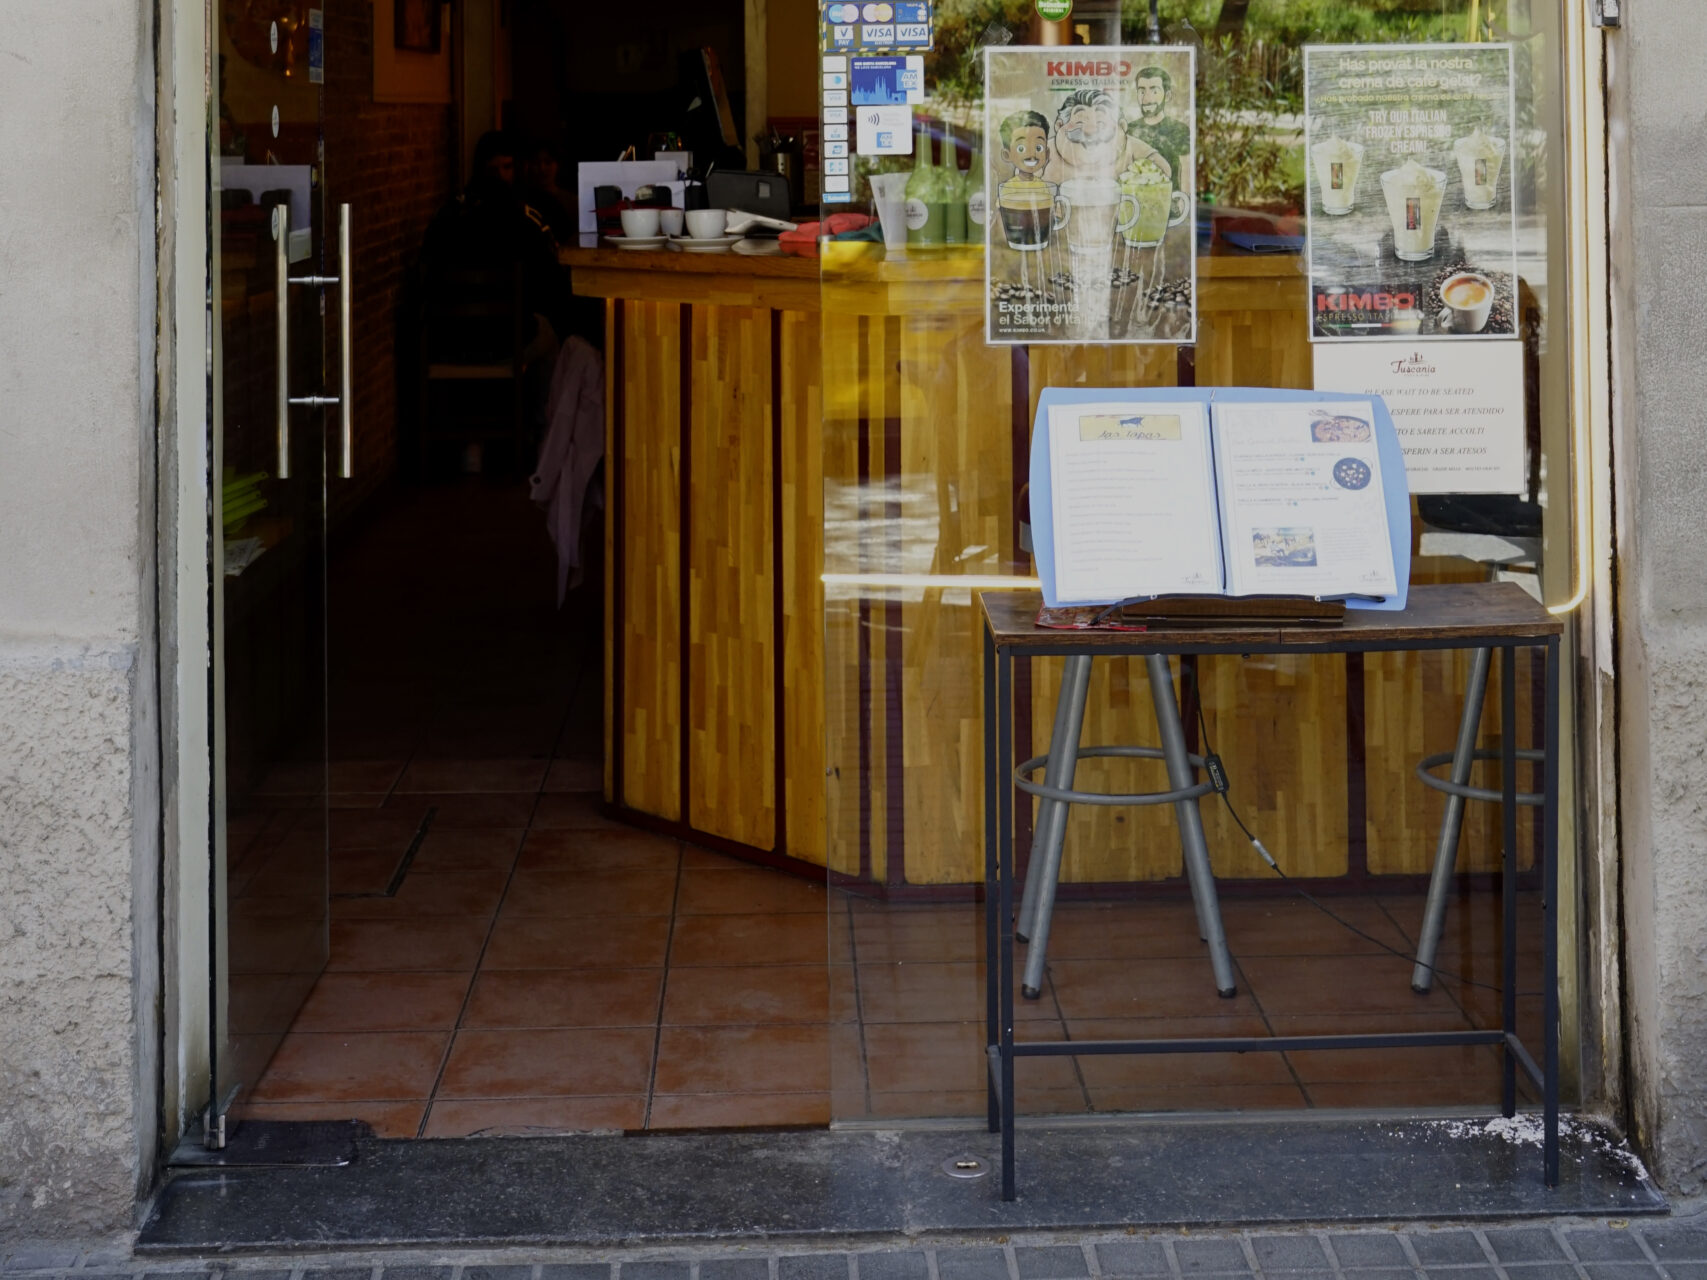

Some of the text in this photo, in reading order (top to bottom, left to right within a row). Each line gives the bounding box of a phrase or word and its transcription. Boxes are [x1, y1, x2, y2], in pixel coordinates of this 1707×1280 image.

[866, 28, 893, 38] VISA
[900, 27, 927, 37] VISA
[1047, 60, 1132, 77] KIMBO
[1339, 56, 1473, 74] Has provat la nostra
[1338, 76, 1384, 90] crema
[1386, 75, 1405, 88] de
[1370, 109, 1448, 123] TRY OUR ITALIAN
[1365, 124, 1452, 139] FROZEN ESPRESSO
[1317, 292, 1415, 312] KIMBO
[999, 314, 1010, 325] el
[1013, 314, 1051, 326] Sabor
[1390, 358, 1436, 375] Tuscania
[1396, 388, 1416, 396] WAIT
[1443, 387, 1475, 395] SEATED
[1390, 407, 1505, 416] ESPERE PARA SER ATENDIDO
[1416, 427, 1448, 435] SARETE
[1449, 427, 1485, 435] ACCOLTI
[1400, 447, 1431, 456] SPERIN
[1440, 447, 1455, 455] SER
[1456, 446, 1488, 455] ATESOS
